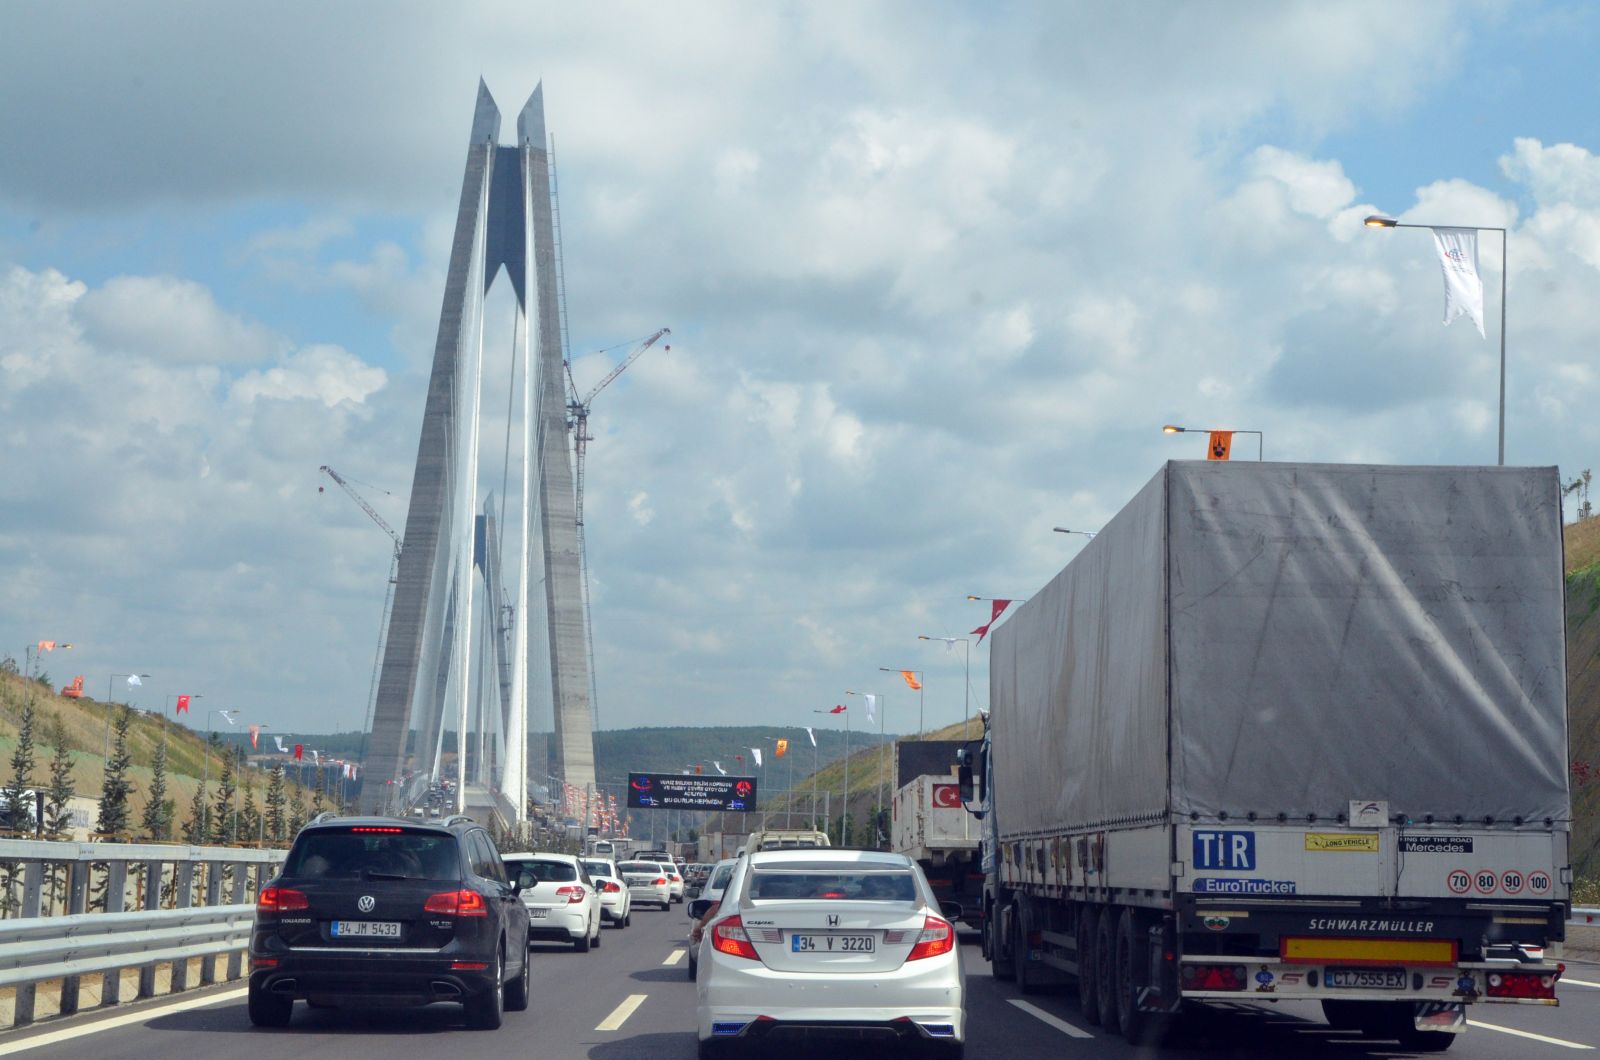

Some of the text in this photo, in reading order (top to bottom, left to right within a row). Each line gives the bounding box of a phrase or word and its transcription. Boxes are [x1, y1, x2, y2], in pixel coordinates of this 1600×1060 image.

[1325, 838, 1370, 847] LONG VEHICLE
[1405, 842, 1465, 853] Mercedes
[1206, 879, 1295, 893] EuroTrucker
[1452, 875, 1468, 887] 70
[1478, 875, 1494, 888] 80
[1505, 875, 1521, 888] 90
[1531, 877, 1547, 889] 100
[339, 922, 397, 936] 34 JM 5433
[1309, 919, 1434, 932] SCHWARZMÜLLER
[800, 937, 873, 951] 34 V 3220
